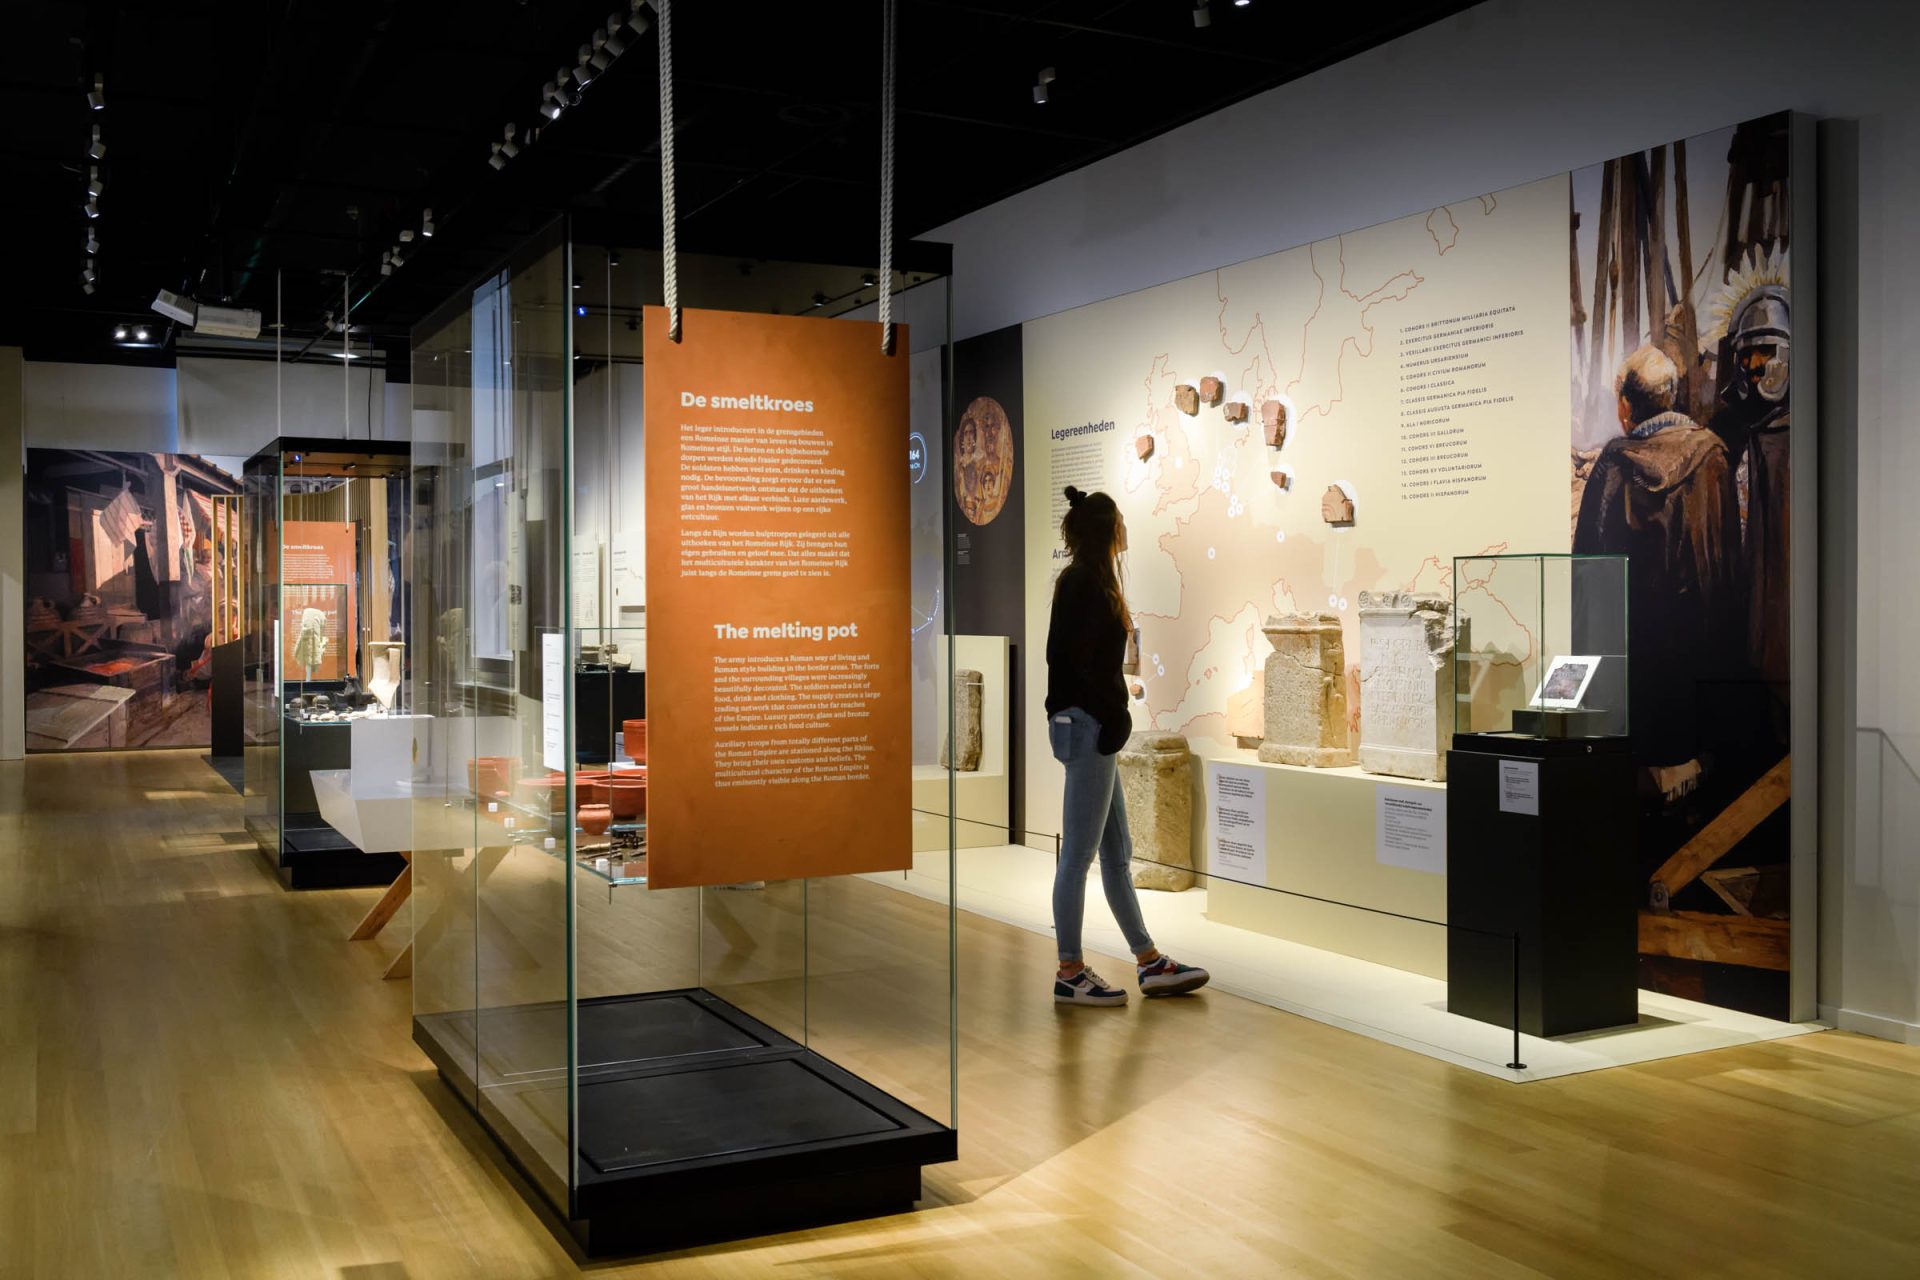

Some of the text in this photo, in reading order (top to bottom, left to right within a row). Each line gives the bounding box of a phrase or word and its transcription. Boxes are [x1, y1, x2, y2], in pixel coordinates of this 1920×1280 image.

[681, 392, 814, 411] De smeltkroes
[713, 425, 756, 434] introduceert
[1051, 420, 1115, 440] Legereenheden
[694, 434, 825, 446] Romeinse manier bouwen
[681, 443, 715, 452] Romeinse
[743, 445, 765, 453] forten
[681, 453, 706, 463] dorpen
[707, 454, 734, 462] werden
[734, 455, 757, 463] steeds
[691, 463, 845, 477] soldaten hebben drinken kleding
[714, 474, 760, 484] bevoorrading
[700, 483, 757, 492] handelsnetwerk
[809, 486, 843, 494] uithoeken
[738, 494, 760, 502] elkaar
[706, 503, 792, 514] bronzen vaatwerk wijzen
[728, 529, 827, 540] worden hulptroepen gelegerd
[681, 538, 833, 549] uithoeken Romeinse brengen
[701, 548, 769, 558] gebruiken geloof
[694, 558, 834, 566] multiculturele karakter Romeinse
[714, 621, 858, 641] The melting pot
[747, 653, 857, 662] introduces Roman living
[714, 665, 739, 673] Roman
[739, 665, 756, 674] style
[757, 664, 786, 674] building
[807, 663, 829, 671] border
[864, 662, 879, 670] forts
[741, 672, 866, 684] surrounding villages increasingly
[714, 684, 752, 694] beautifully
[803, 682, 830, 690] soldiers
[733, 694, 753, 702] drink
[811, 692, 834, 702] supply
[835, 691, 859, 699] creates
[864, 690, 880, 700] large
[714, 700, 865, 714] trading network connects reaches
[764, 712, 788, 722] Luxury
[816, 711, 833, 720] glass
[847, 710, 870, 718] bronze
[715, 724, 739, 732] vessels
[740, 722, 768, 731] indicate
[715, 734, 859, 750] Auxiliary troops totally different parts
[728, 749, 752, 757] Roman
[752, 748, 777, 758] Empire
[790, 746, 822, 754] stationed
[822, 745, 841, 755] along
[732, 758, 751, 769] bring
[752, 758, 769, 766] their
[786, 755, 815, 764] customs
[715, 763, 862, 777] multicultural character Roman Empire
[731, 777, 766, 788] eminently
[768, 776, 790, 784] visible
[791, 775, 810, 785] along
[823, 773, 846, 782] Roman
